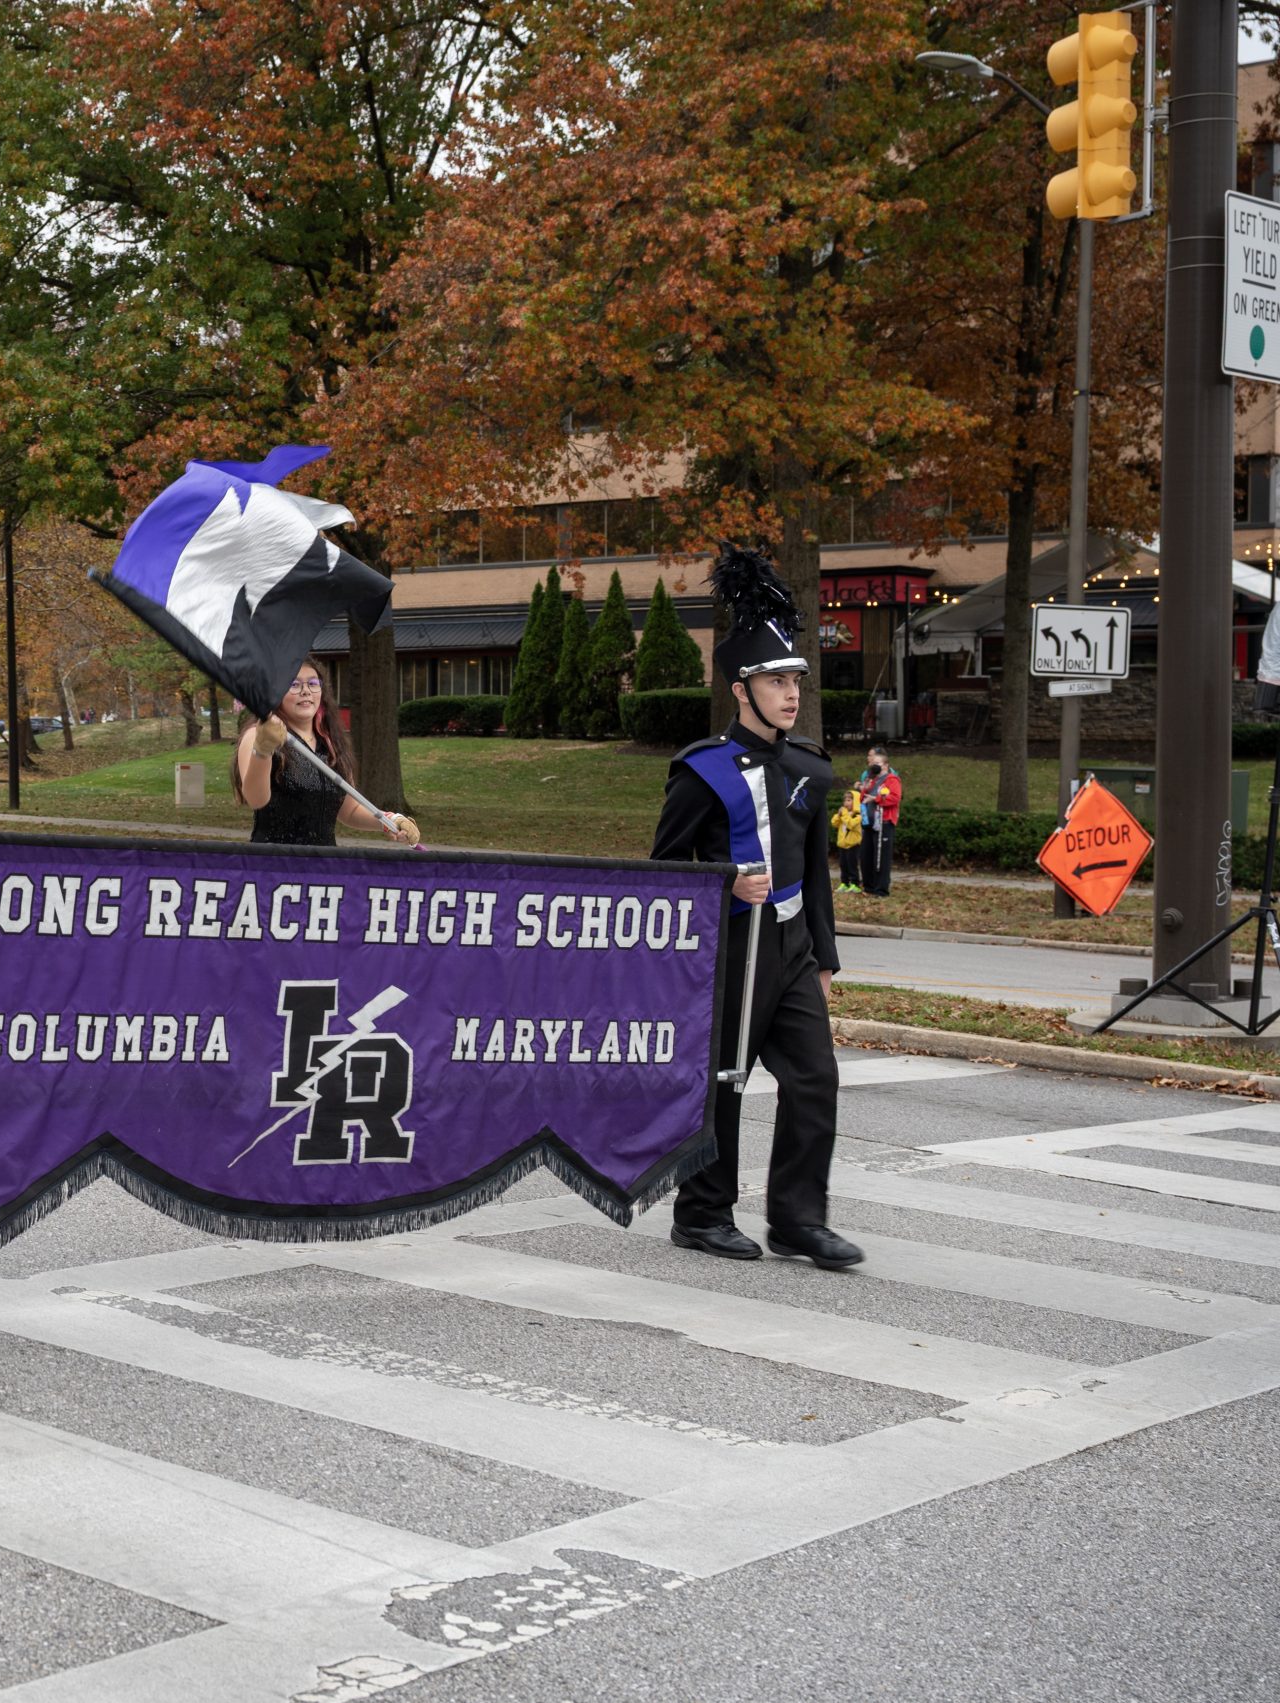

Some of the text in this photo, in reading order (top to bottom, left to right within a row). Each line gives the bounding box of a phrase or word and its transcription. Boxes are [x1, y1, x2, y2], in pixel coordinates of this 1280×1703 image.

[1234, 209, 1257, 237] LEFT
[1243, 246, 1277, 280] YIELD
[1233, 292, 1247, 316] ON
[1037, 657, 1093, 672] ONLY ONLY
[1077, 683, 1095, 691] SIGNAL
[1065, 824, 1131, 853] DETOUR
[145, 878, 344, 943] REACH
[364, 886, 497, 947] HIGH
[516, 893, 701, 951] SCHOOL
[451, 1017, 677, 1064] MARYLAND
